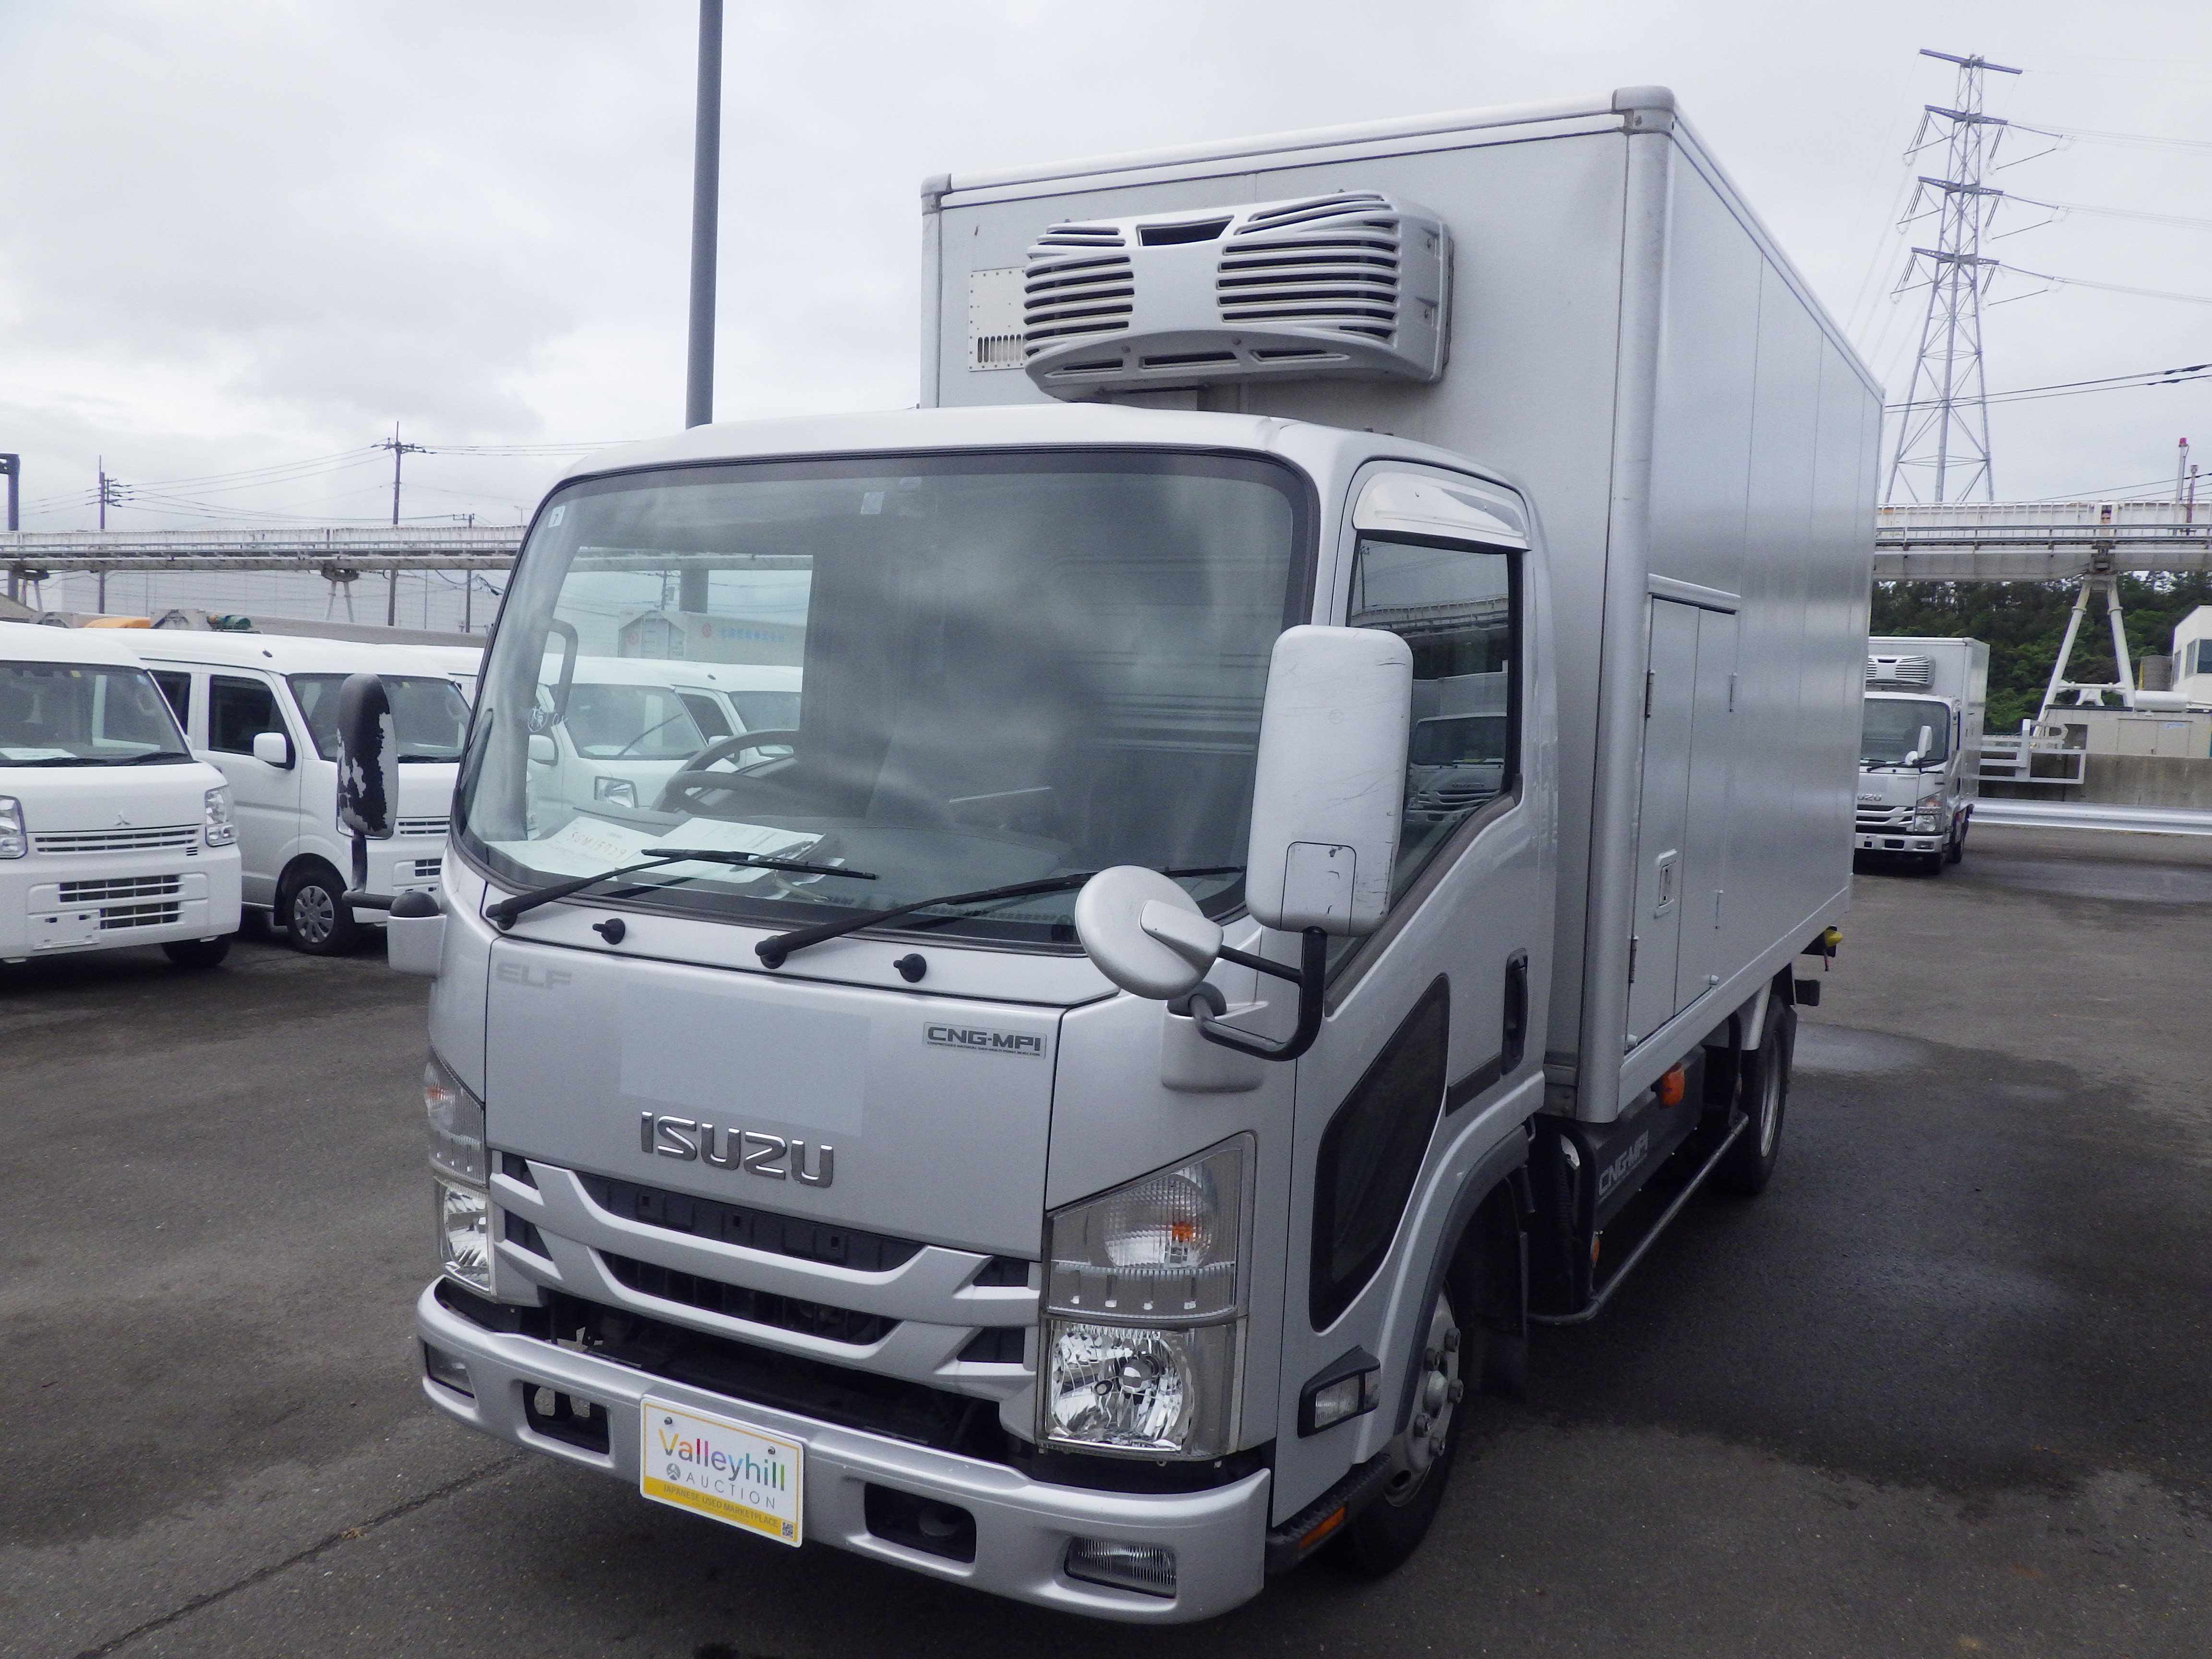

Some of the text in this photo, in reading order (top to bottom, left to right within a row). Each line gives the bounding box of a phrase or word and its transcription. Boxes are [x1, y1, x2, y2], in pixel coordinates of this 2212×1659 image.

[496, 962, 572, 989] ELF
[928, 1026, 1041, 1051] CNG-MPI
[641, 1111, 834, 1188] ISUZU
[659, 1429, 784, 1491] Valleyhill
[663, 1484, 700, 1502] JAPANESE
[702, 1496, 722, 1509] USED
[723, 1503, 779, 1528] MARKETPLACE
[686, 1472, 775, 1510] AUCTION
